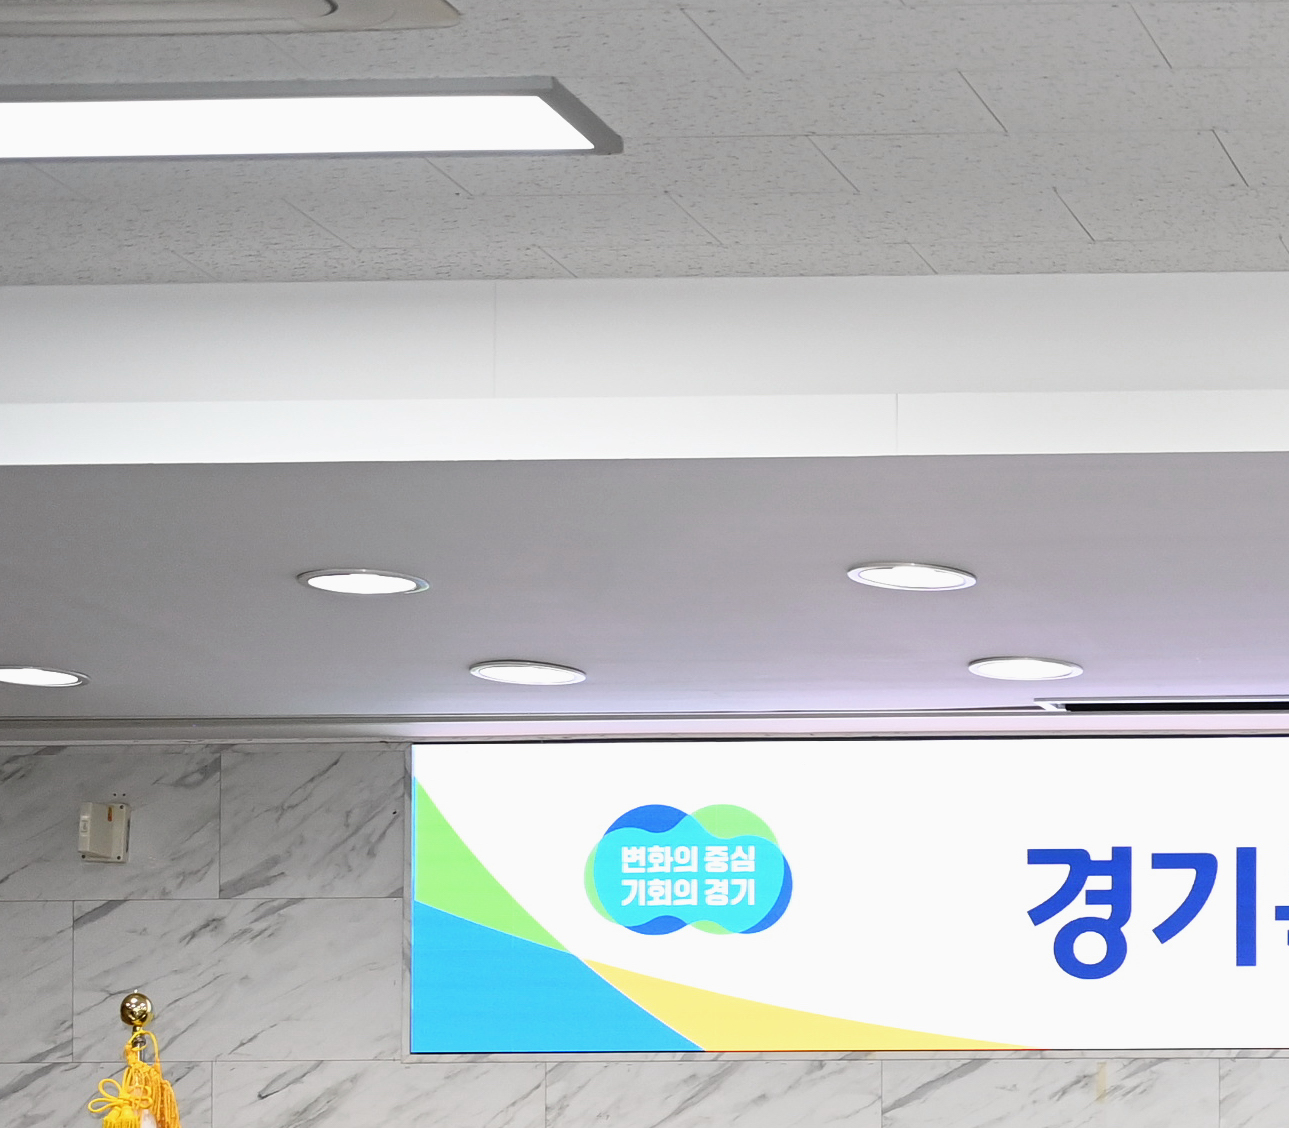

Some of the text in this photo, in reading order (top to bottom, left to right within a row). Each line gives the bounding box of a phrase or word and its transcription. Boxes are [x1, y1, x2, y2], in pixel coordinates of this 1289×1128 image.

[621, 844, 756, 873] 변화의 중심
[621, 878, 756, 907] 기회의 경기
